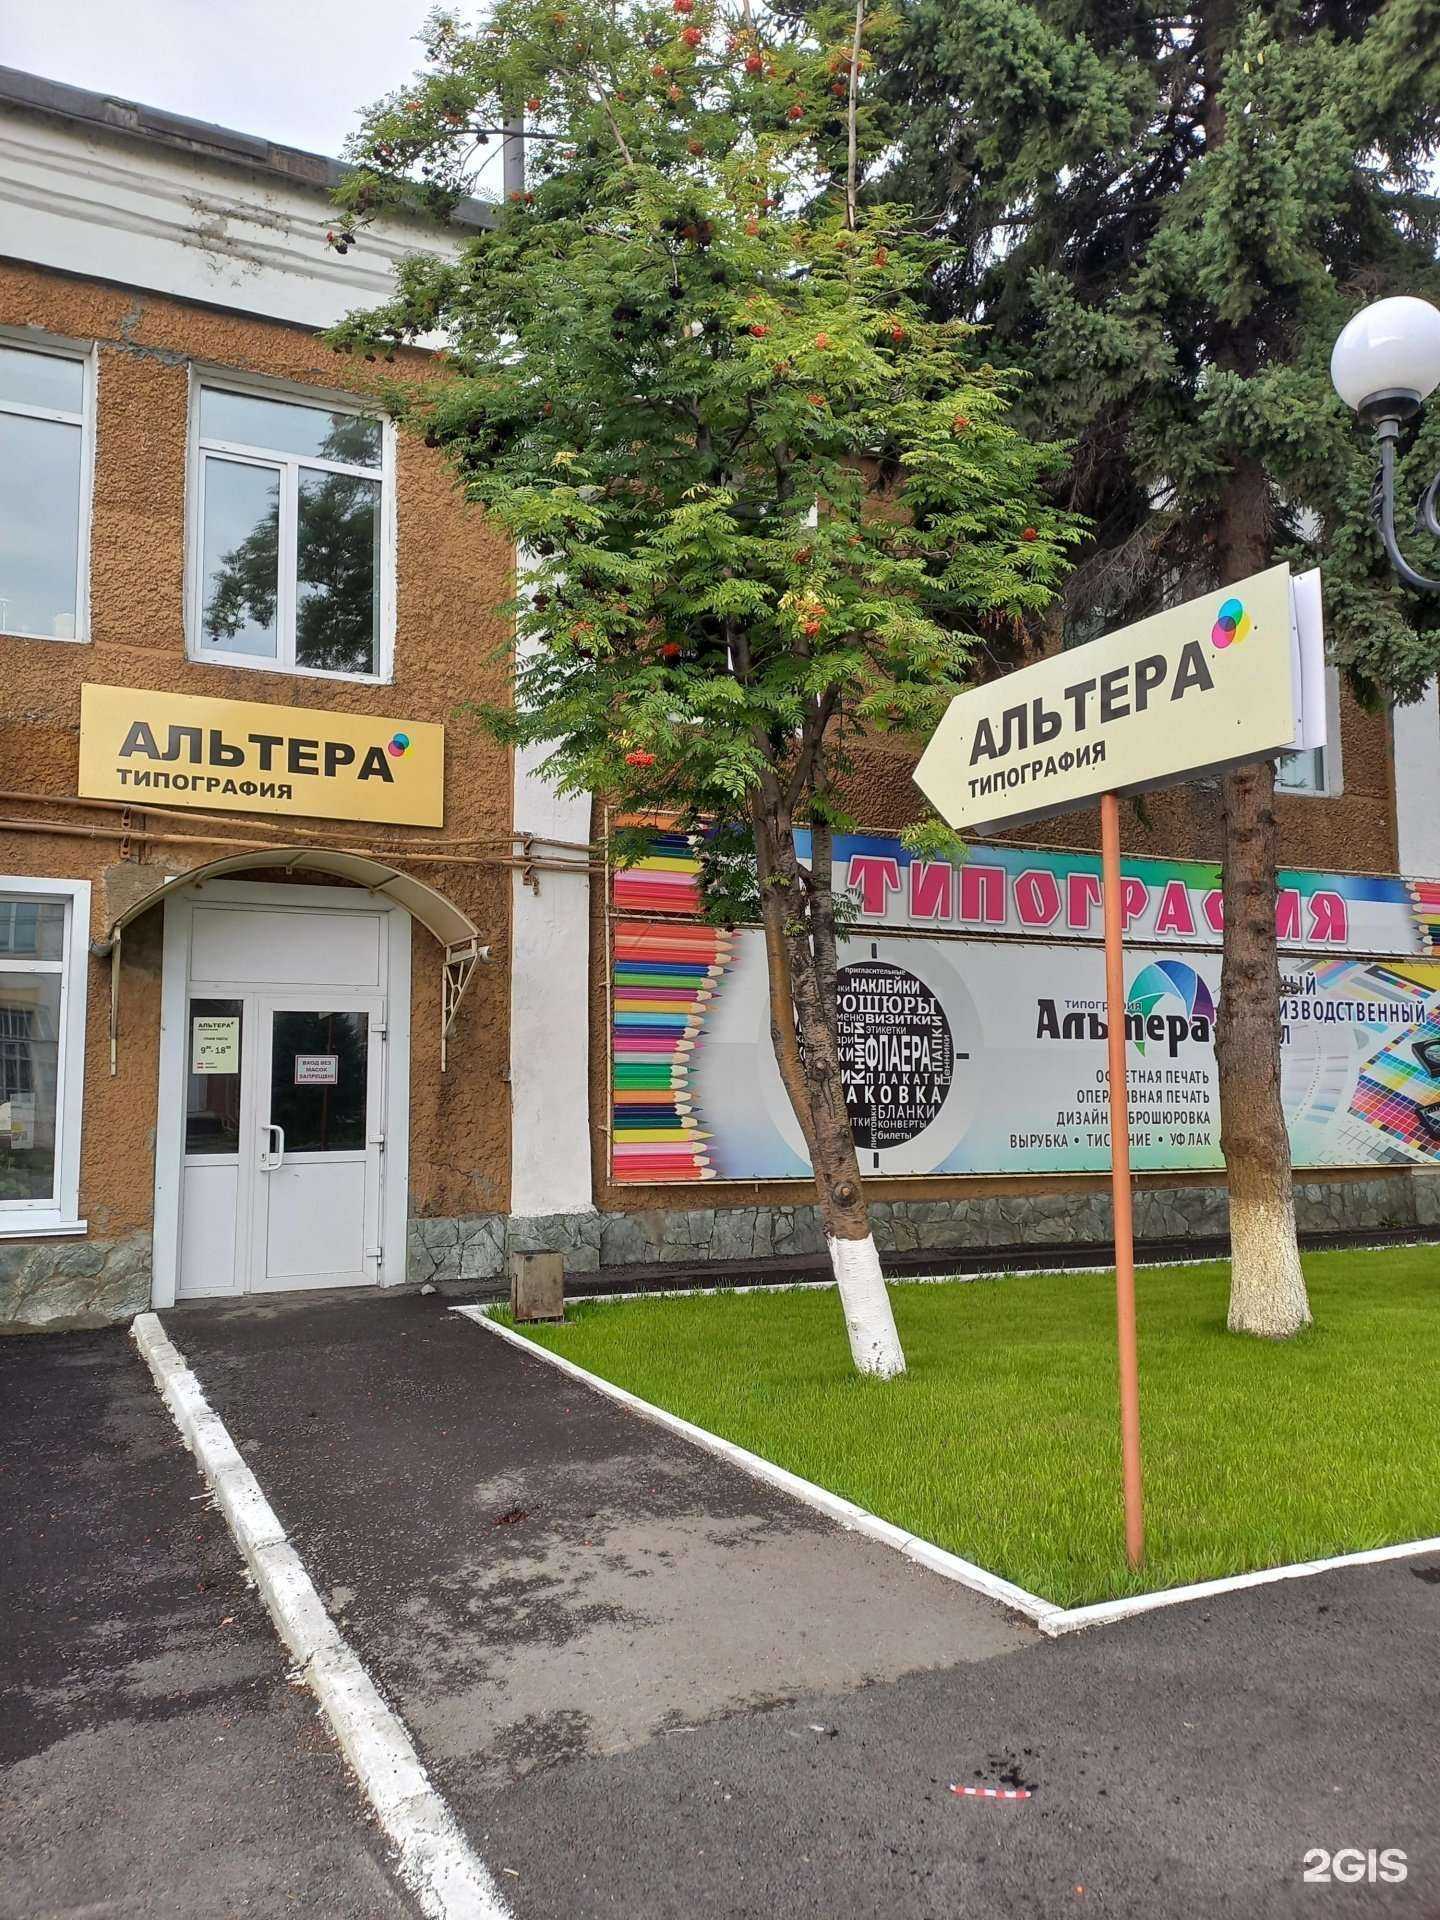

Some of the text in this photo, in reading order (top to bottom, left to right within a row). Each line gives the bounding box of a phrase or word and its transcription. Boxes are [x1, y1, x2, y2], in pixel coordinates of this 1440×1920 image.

[968, 640, 1215, 766] АЛЬТЕРА
[118, 721, 394, 783] АЛЬТЕРА
[968, 740, 1106, 798] ТИПОГРАФИЯ
[116, 768, 293, 800] ТИПОГРАФИЯ
[847, 854, 1348, 944] ТИПОГРАИЯ
[851, 977, 920, 995] НАКЛЕЙКИ
[836, 995, 937, 1015] ОШЮРЫ
[1279, 1001, 1426, 1023] ИЗВОДСТВЕННЫЙ
[866, 1025, 907, 1035] этикетки
[931, 1015, 943, 1072] ПАПКИ
[865, 1035, 932, 1072] ФЛАЕРА
[866, 1073, 943, 1085] ПЛАКАТЫ
[1096, 1070, 1209, 1084] ОЕТНАЯ ПЕЧАТЬ
[846, 1085, 942, 1104] АКОВКА
[1166, 1090, 1210, 1104] ПЕЧАТЬ
[878, 1104, 935, 1119] БЛАНКИ
[1057, 1109, 1211, 1127] ДИЗАЙН БРОШЮРОВКА
[878, 1131, 912, 1140] билеты
[1010, 1134, 1068, 1148] ВЫРУБКА
[1086, 1133, 1151, 1147] ТИСНИЕ
